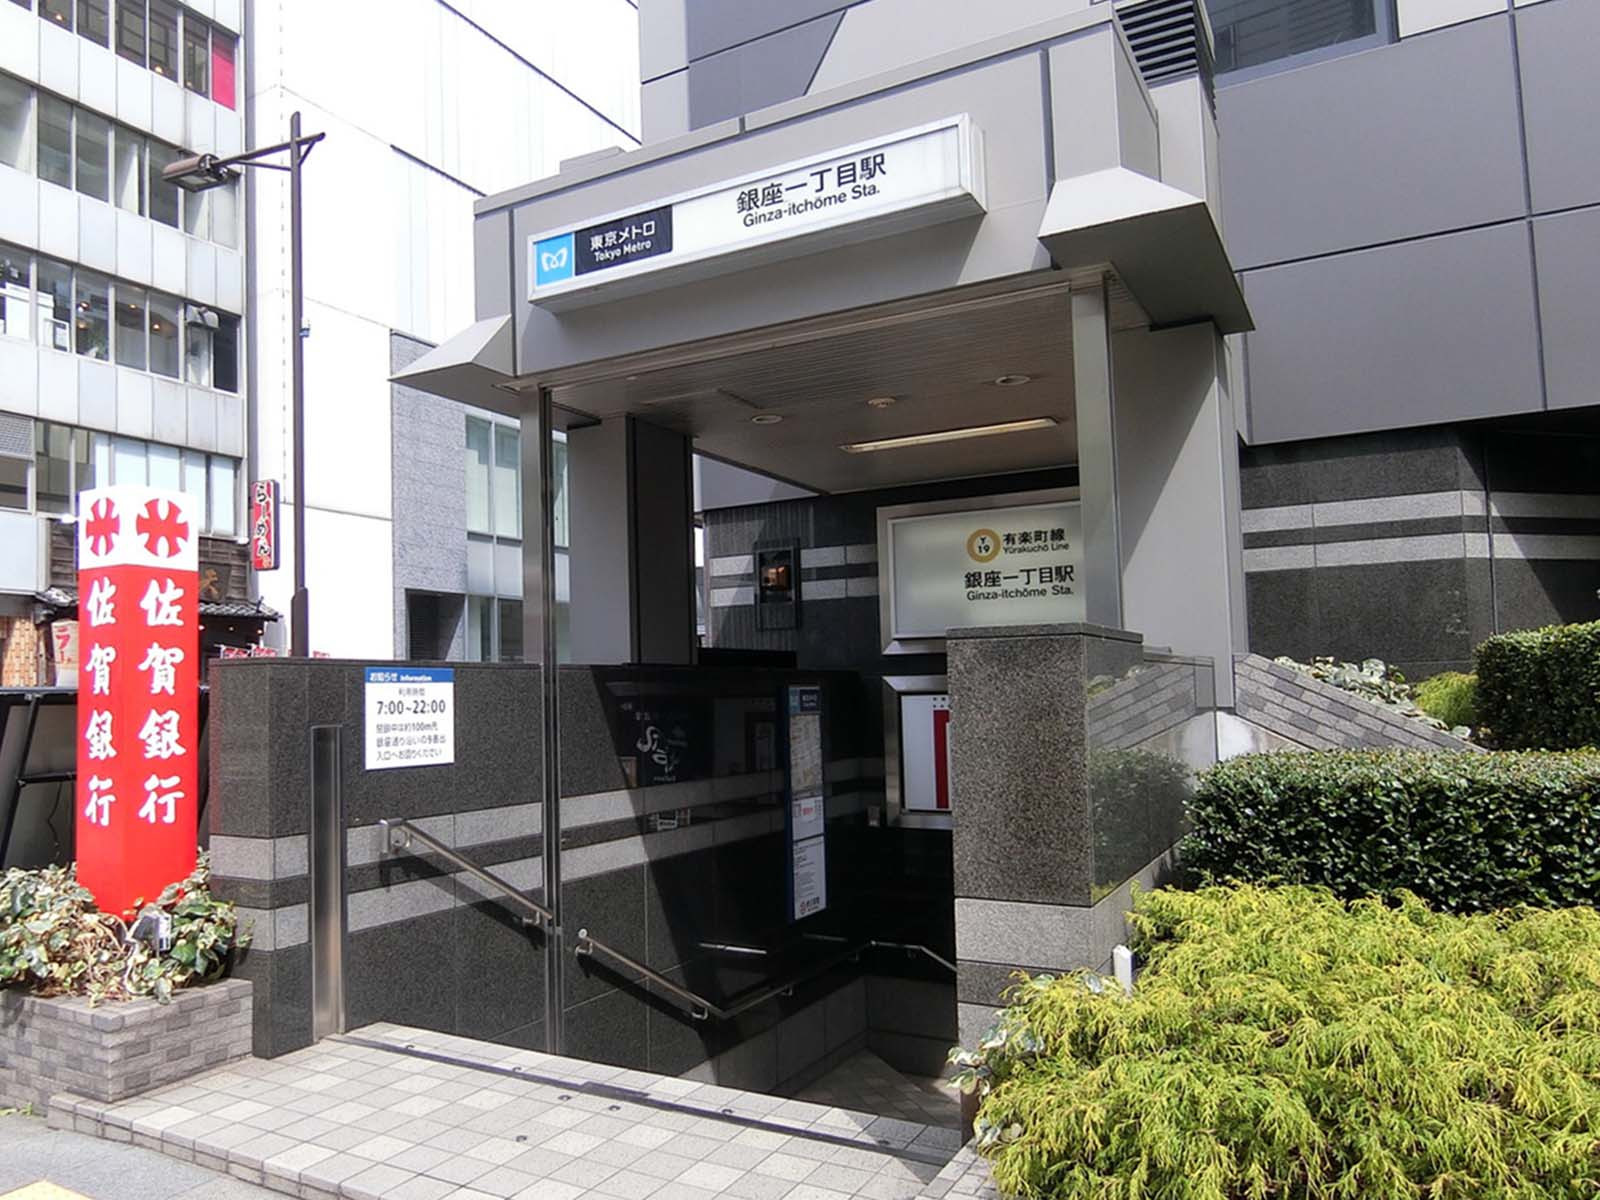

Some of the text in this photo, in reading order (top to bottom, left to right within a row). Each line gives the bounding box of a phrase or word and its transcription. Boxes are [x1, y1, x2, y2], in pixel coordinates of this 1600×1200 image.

[737, 153, 886, 214] 銀座一丁目駅
[743, 184, 880, 227] Ginza-itchōme Sta.
[590, 220, 656, 251] 東京メトロ
[594, 240, 652, 262] Tokyo Metro
[256, 485, 270, 556] らーめん
[979, 537, 987, 545] Y
[1002, 528, 1065, 545] 有楽町線
[1003, 542, 1069, 555] Yūrakuchō Line
[977, 545, 990, 553] 19
[964, 565, 1075, 589] 銀座一丁目駅
[966, 585, 1074, 601] Ginza-itchōme Sta.
[84, 576, 117, 826] 佐賀銀行
[138, 578, 186, 824] 佐賀銀行
